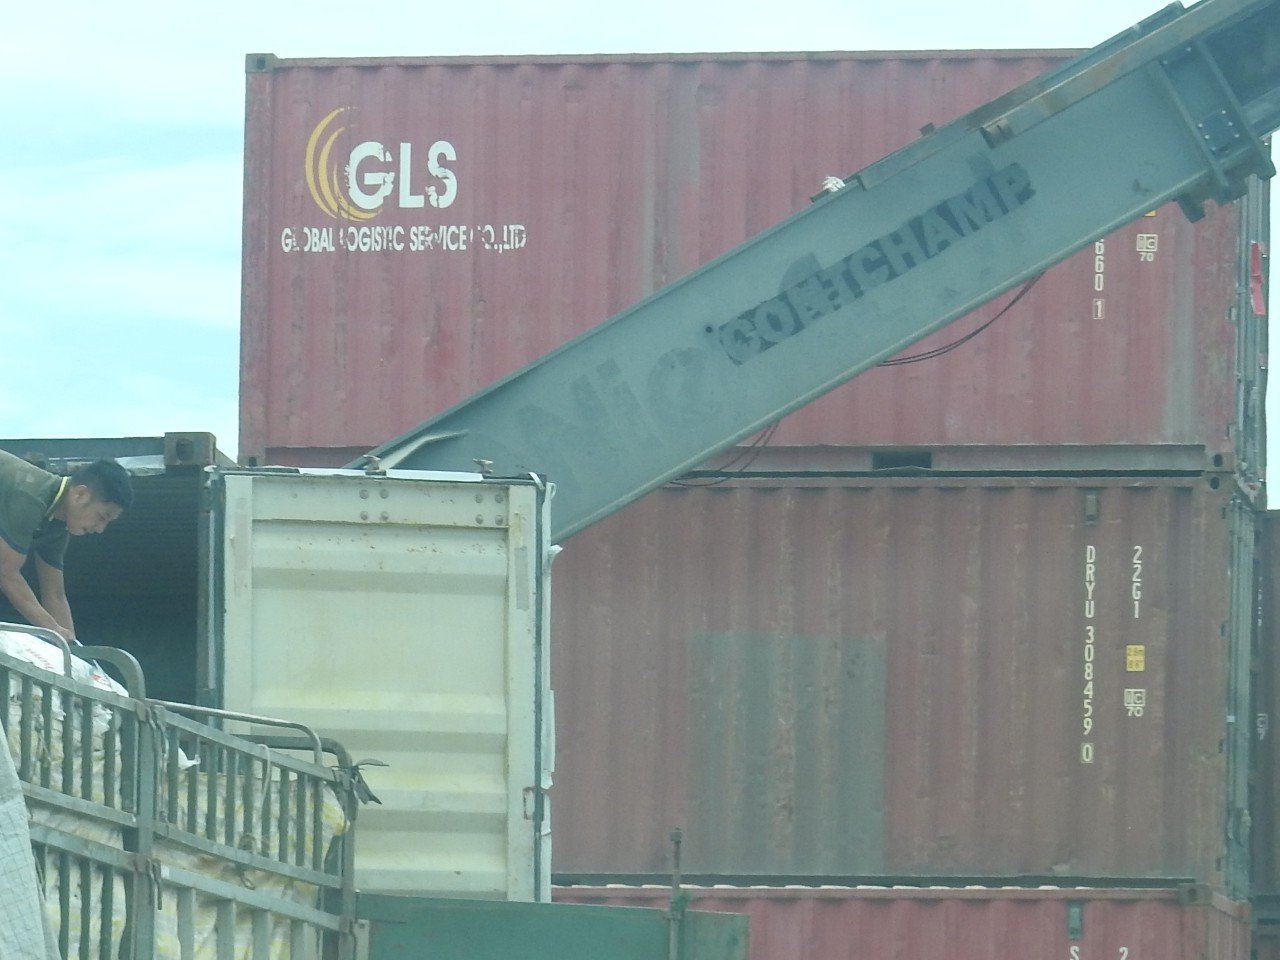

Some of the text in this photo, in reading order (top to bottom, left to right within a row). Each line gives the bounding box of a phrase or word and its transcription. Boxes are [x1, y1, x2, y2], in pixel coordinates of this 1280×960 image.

[346, 141, 457, 209] GLS
[281, 227, 335, 253] GOBAL
[1084, 545, 1096, 619] DRYU
[1130, 545, 1143, 619] 22G1
[1083, 625, 1095, 735] 308459
